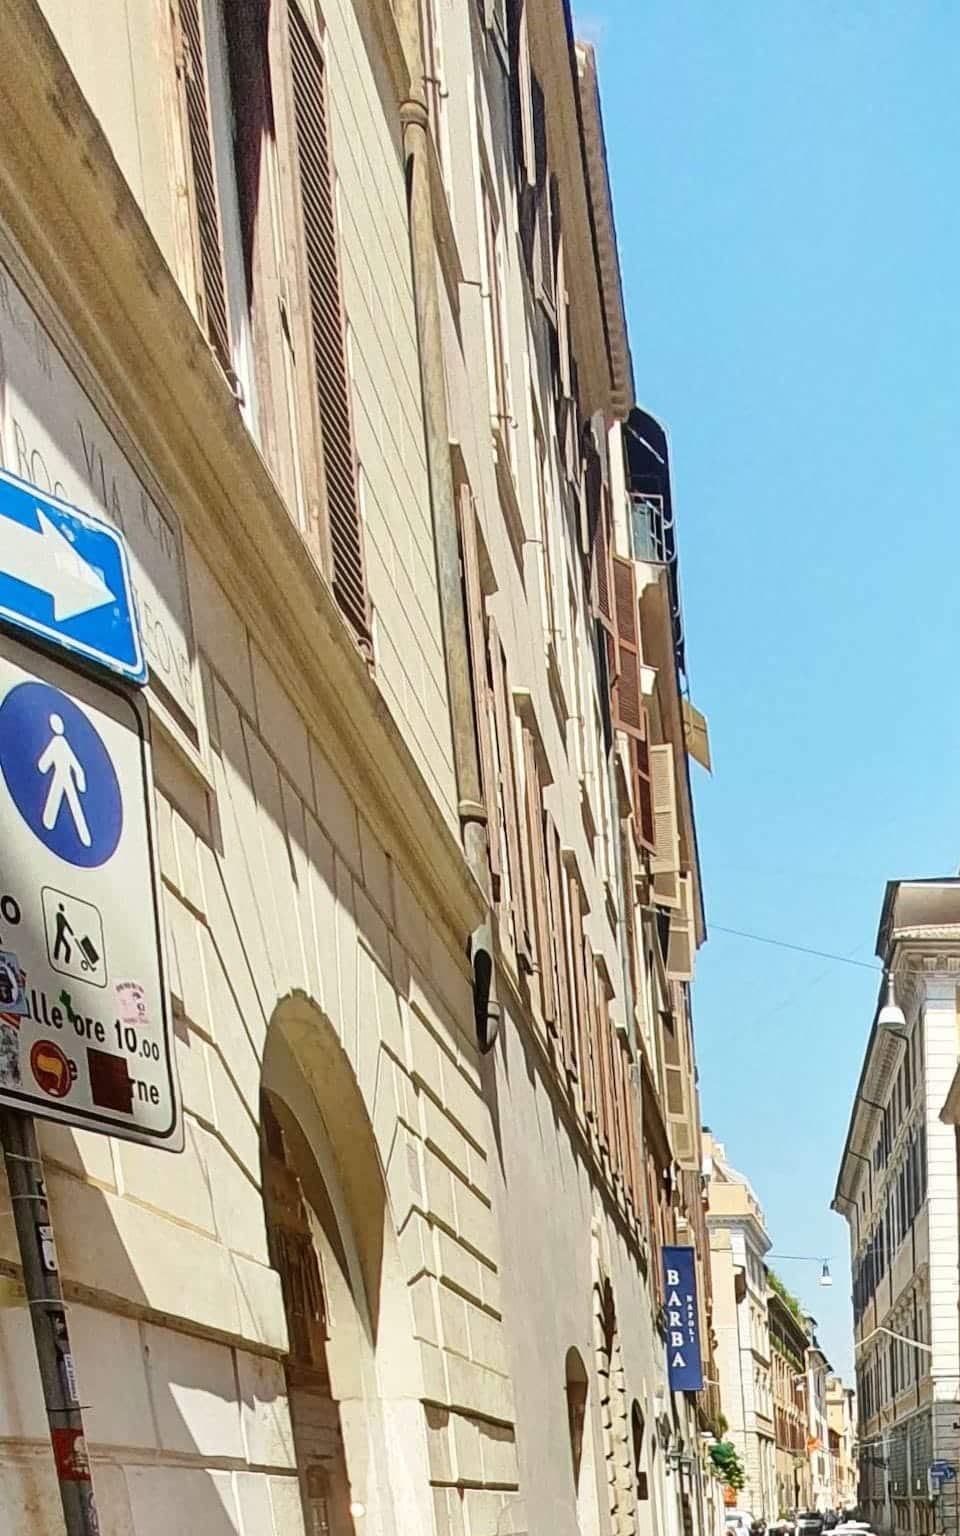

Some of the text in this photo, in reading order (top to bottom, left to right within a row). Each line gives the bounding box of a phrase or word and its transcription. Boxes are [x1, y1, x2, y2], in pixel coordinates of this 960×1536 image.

[76, 418, 127, 537] VIA
[73, 1018, 105, 1044] ore
[115, 1019, 160, 1062] 10.00
[666, 1269, 687, 1367] BARBA
[686, 1294, 695, 1344] NAPOLI
